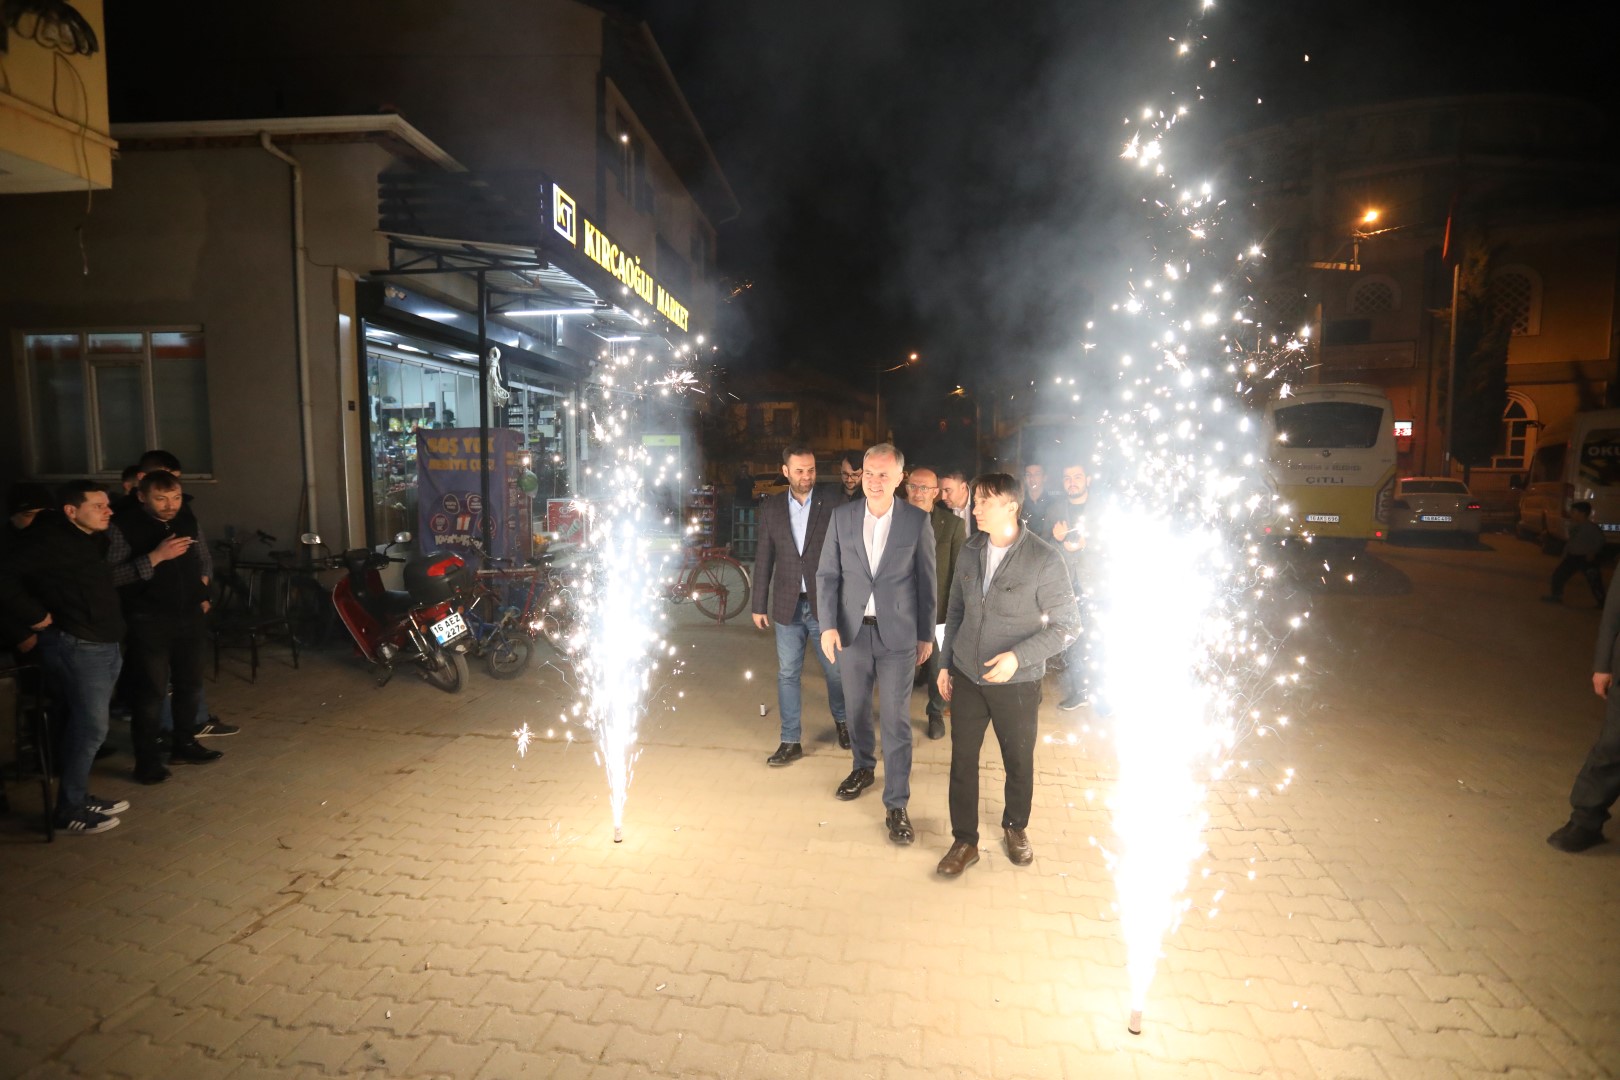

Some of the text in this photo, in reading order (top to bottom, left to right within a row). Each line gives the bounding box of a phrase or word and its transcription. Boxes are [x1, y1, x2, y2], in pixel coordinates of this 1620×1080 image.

[656, 285, 689, 332] MARKET
[434, 615, 460, 633] 16 AEZ
[445, 625, 460, 638] 227
